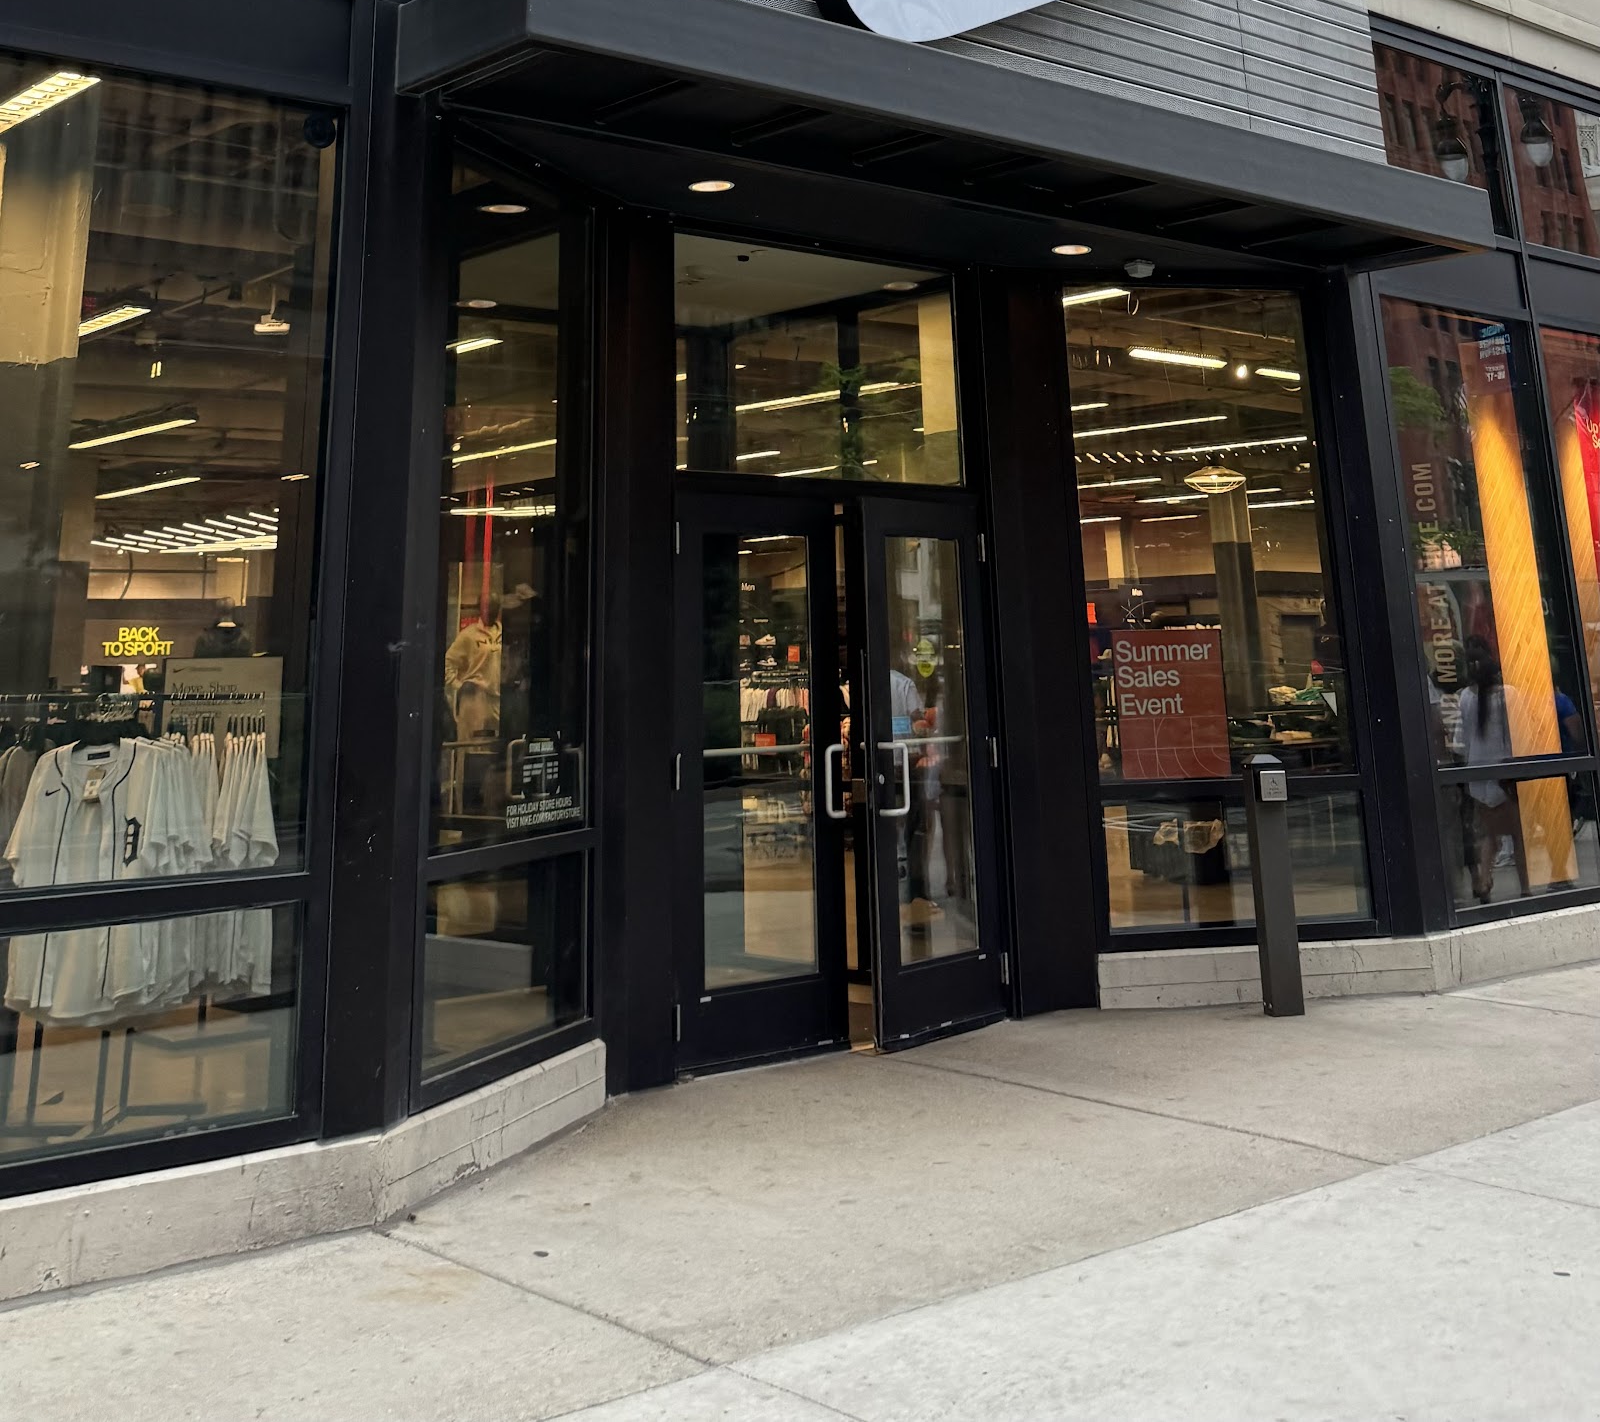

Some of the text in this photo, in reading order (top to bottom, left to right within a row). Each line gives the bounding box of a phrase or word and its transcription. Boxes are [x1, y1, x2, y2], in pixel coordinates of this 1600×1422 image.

[1426, 582, 1448, 608] AT
[118, 626, 160, 642] BACK
[102, 640, 174, 657] TO SPORT
[1115, 639, 1212, 664] Summer
[1430, 616, 1458, 683] MORE
[1117, 664, 1181, 689] Sales
[1120, 692, 1184, 717] Event
[1439, 692, 1465, 749] FIND
[506, 796, 573, 817] FOR HOLIDAY STORE HOURS
[505, 815, 519, 829] VISIT
